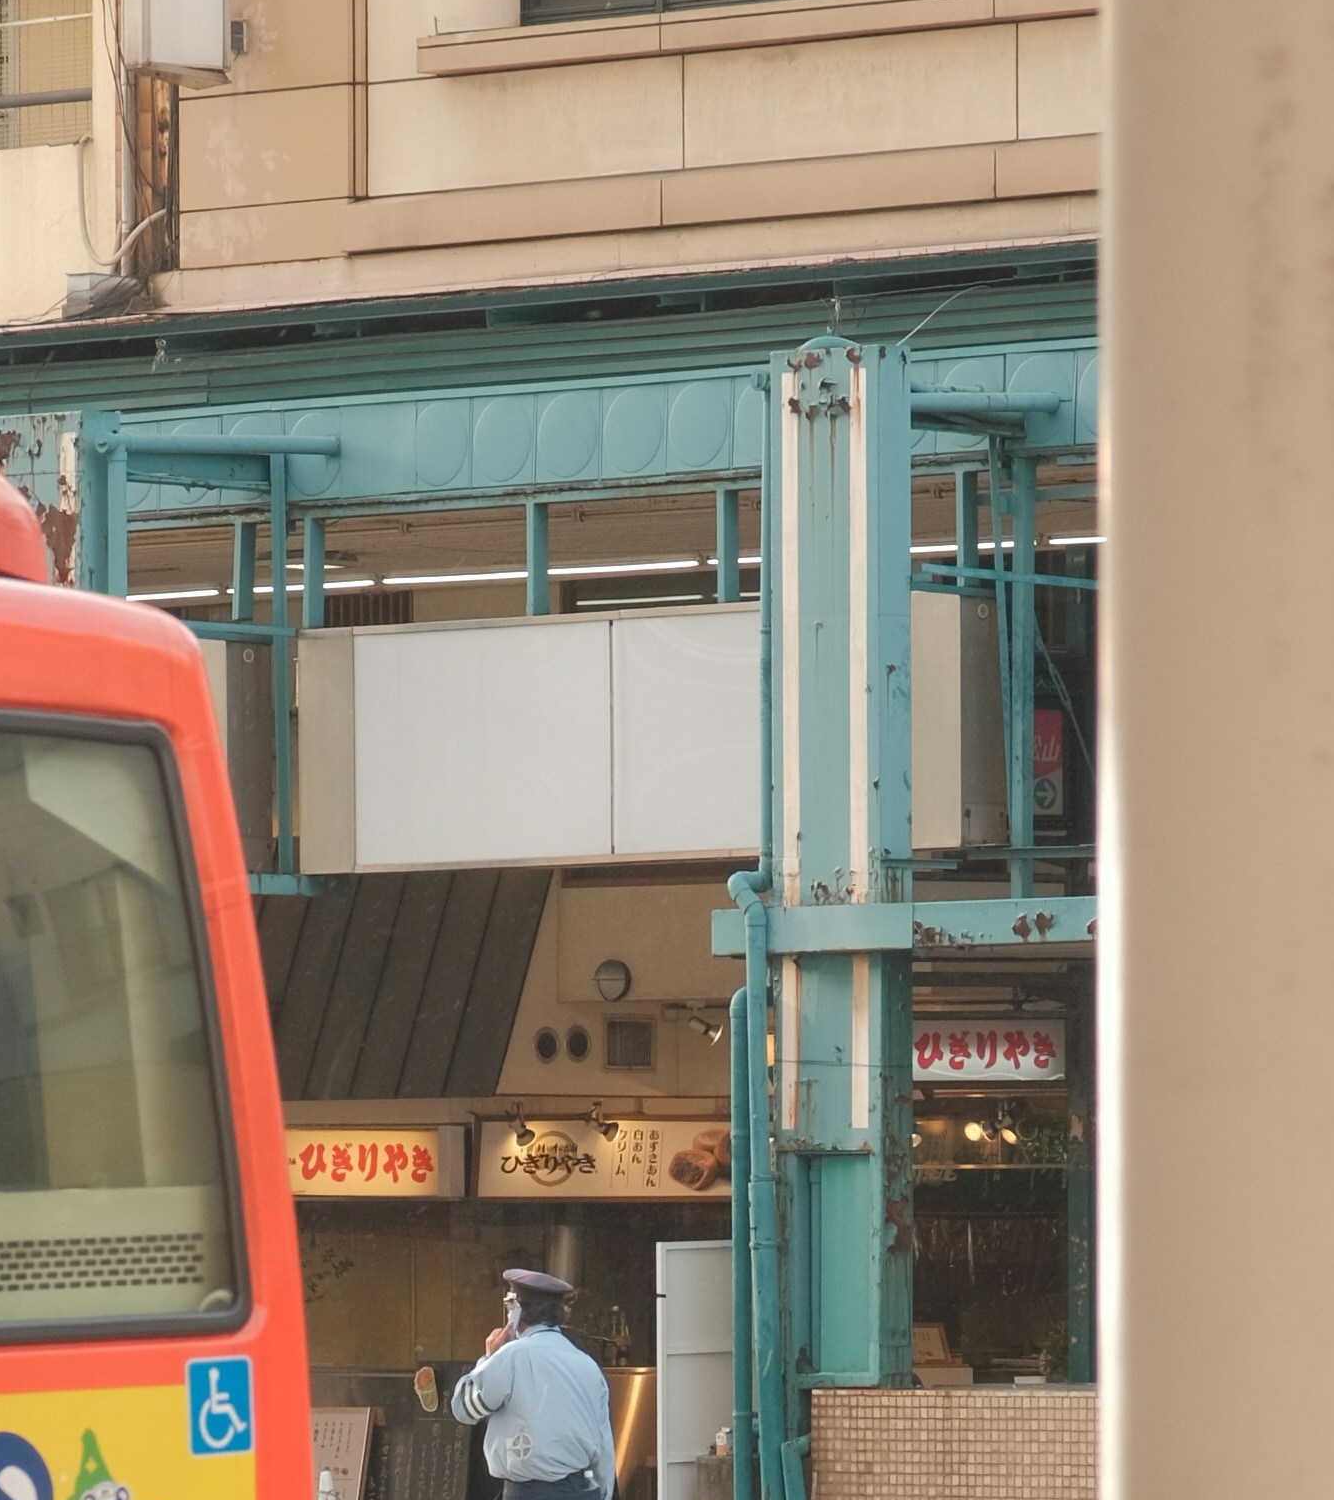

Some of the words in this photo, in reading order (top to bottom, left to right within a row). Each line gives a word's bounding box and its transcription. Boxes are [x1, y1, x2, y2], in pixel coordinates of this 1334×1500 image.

[914, 1029, 1057, 1070] ひぎりやき
[299, 1142, 435, 1184] ひぎりやき
